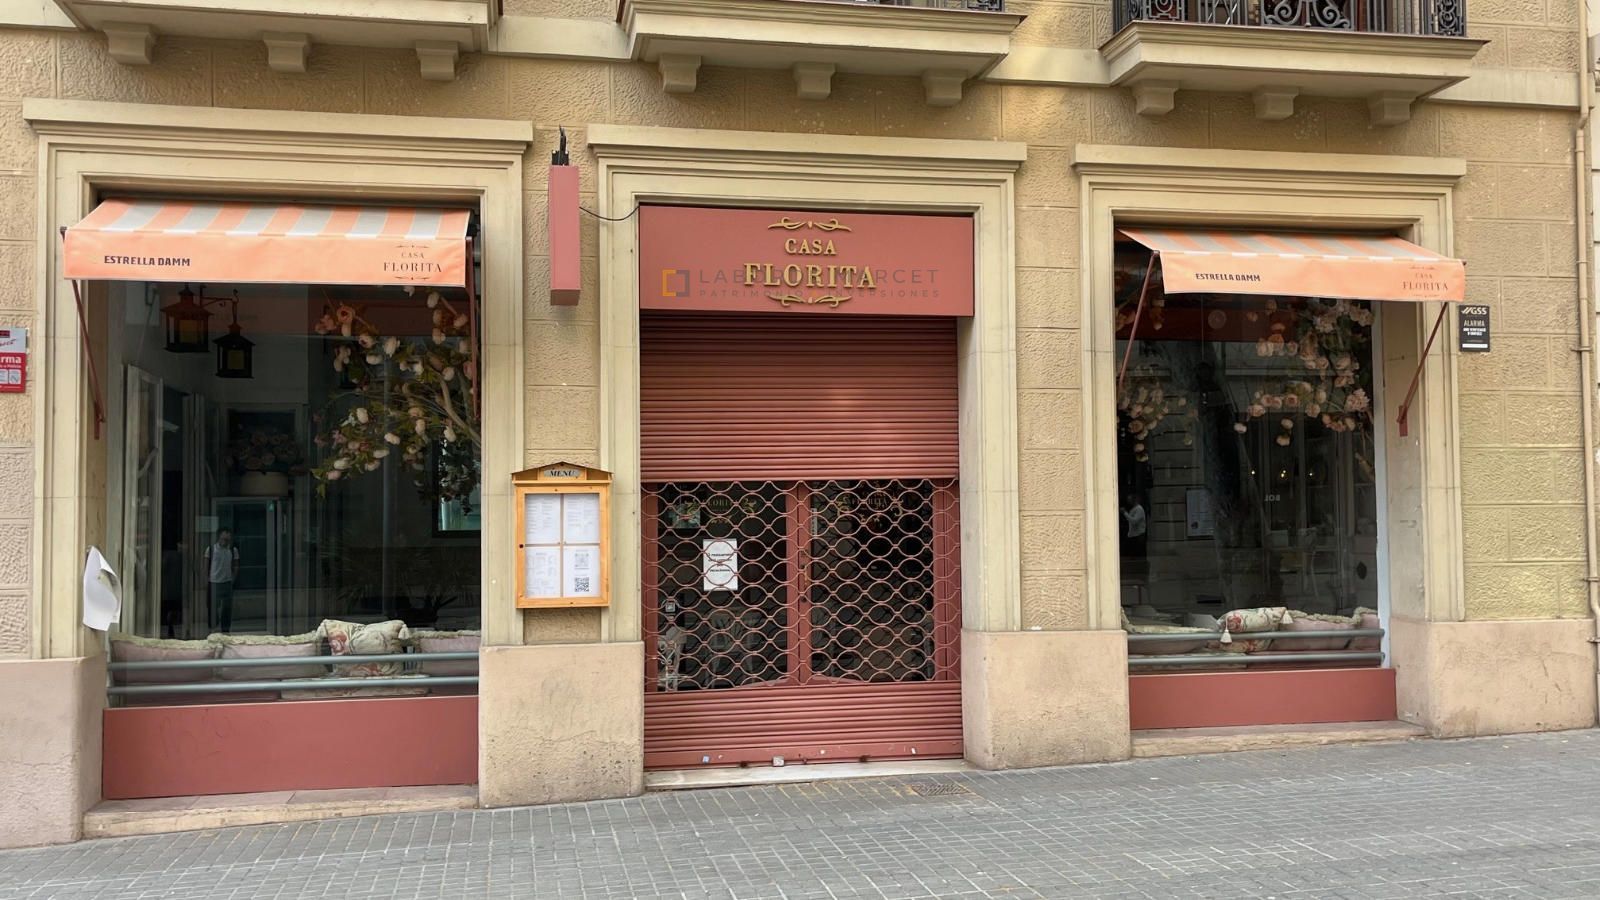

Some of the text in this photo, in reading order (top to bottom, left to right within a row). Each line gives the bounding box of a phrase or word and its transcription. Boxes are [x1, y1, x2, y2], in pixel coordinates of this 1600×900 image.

[785, 238, 837, 255] CASA
[104, 255, 190, 267] ESTRELLA DAMM
[384, 262, 442, 272] FLORITA
[744, 263, 877, 288] FLORITA
[1195, 273, 1261, 282] ESTRELLA DAMM
[1403, 281, 1448, 291] FLORITA
